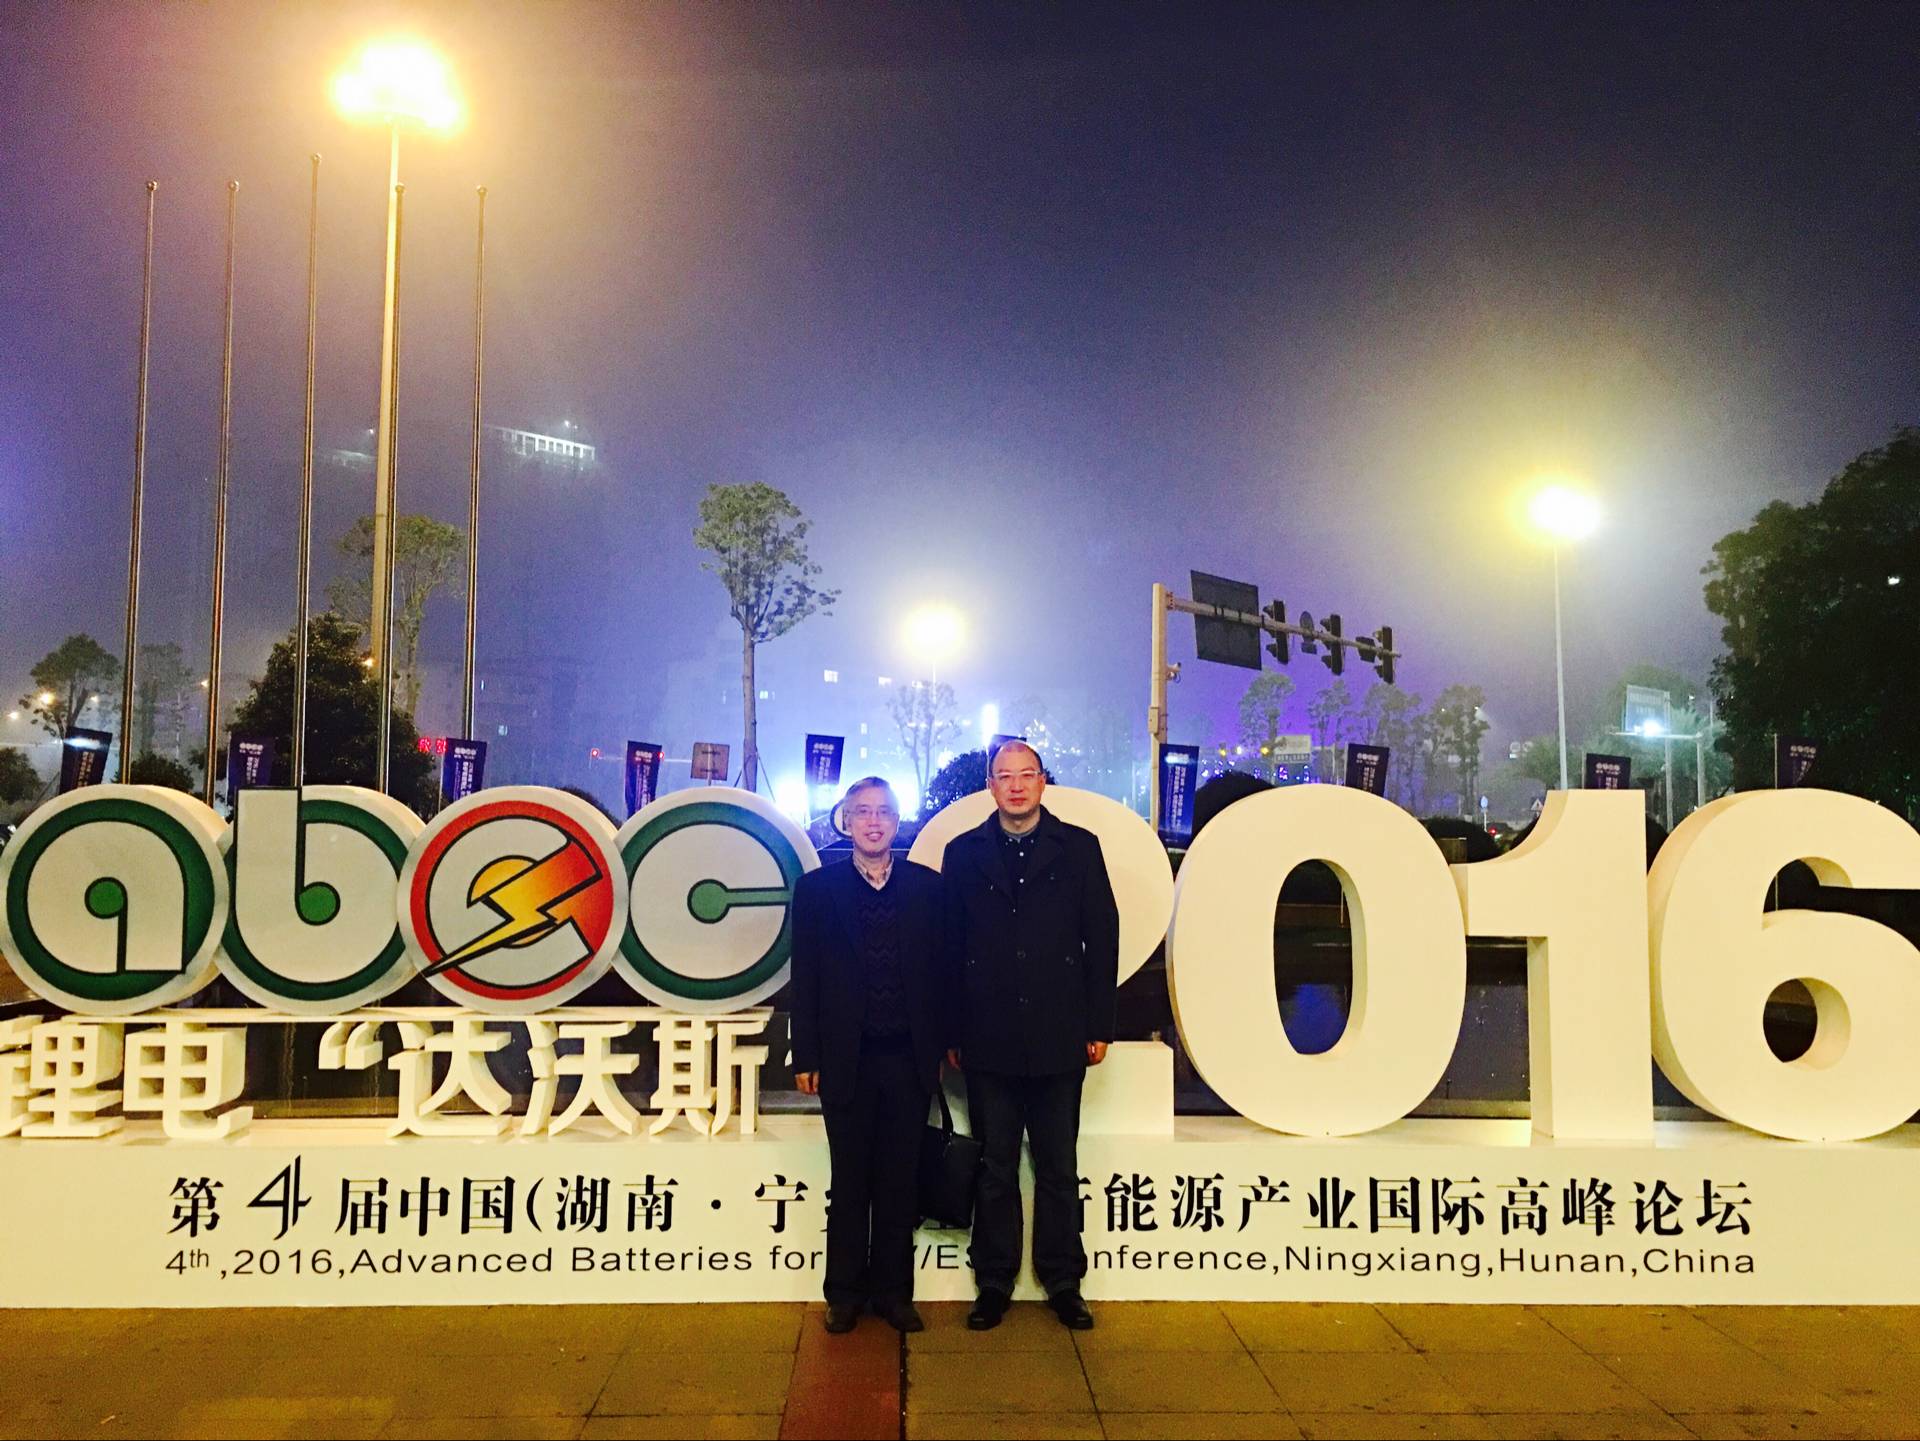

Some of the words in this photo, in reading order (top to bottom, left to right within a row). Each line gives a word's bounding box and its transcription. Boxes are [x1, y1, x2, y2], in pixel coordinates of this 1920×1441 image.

[318, 1019, 794, 1137] “达沃斯
[571, 1246, 753, 1272] Batteries
[769, 1245, 824, 1271] for
[1085, 1244, 1755, 1278] nference,Ningxiang,Hunan,China
